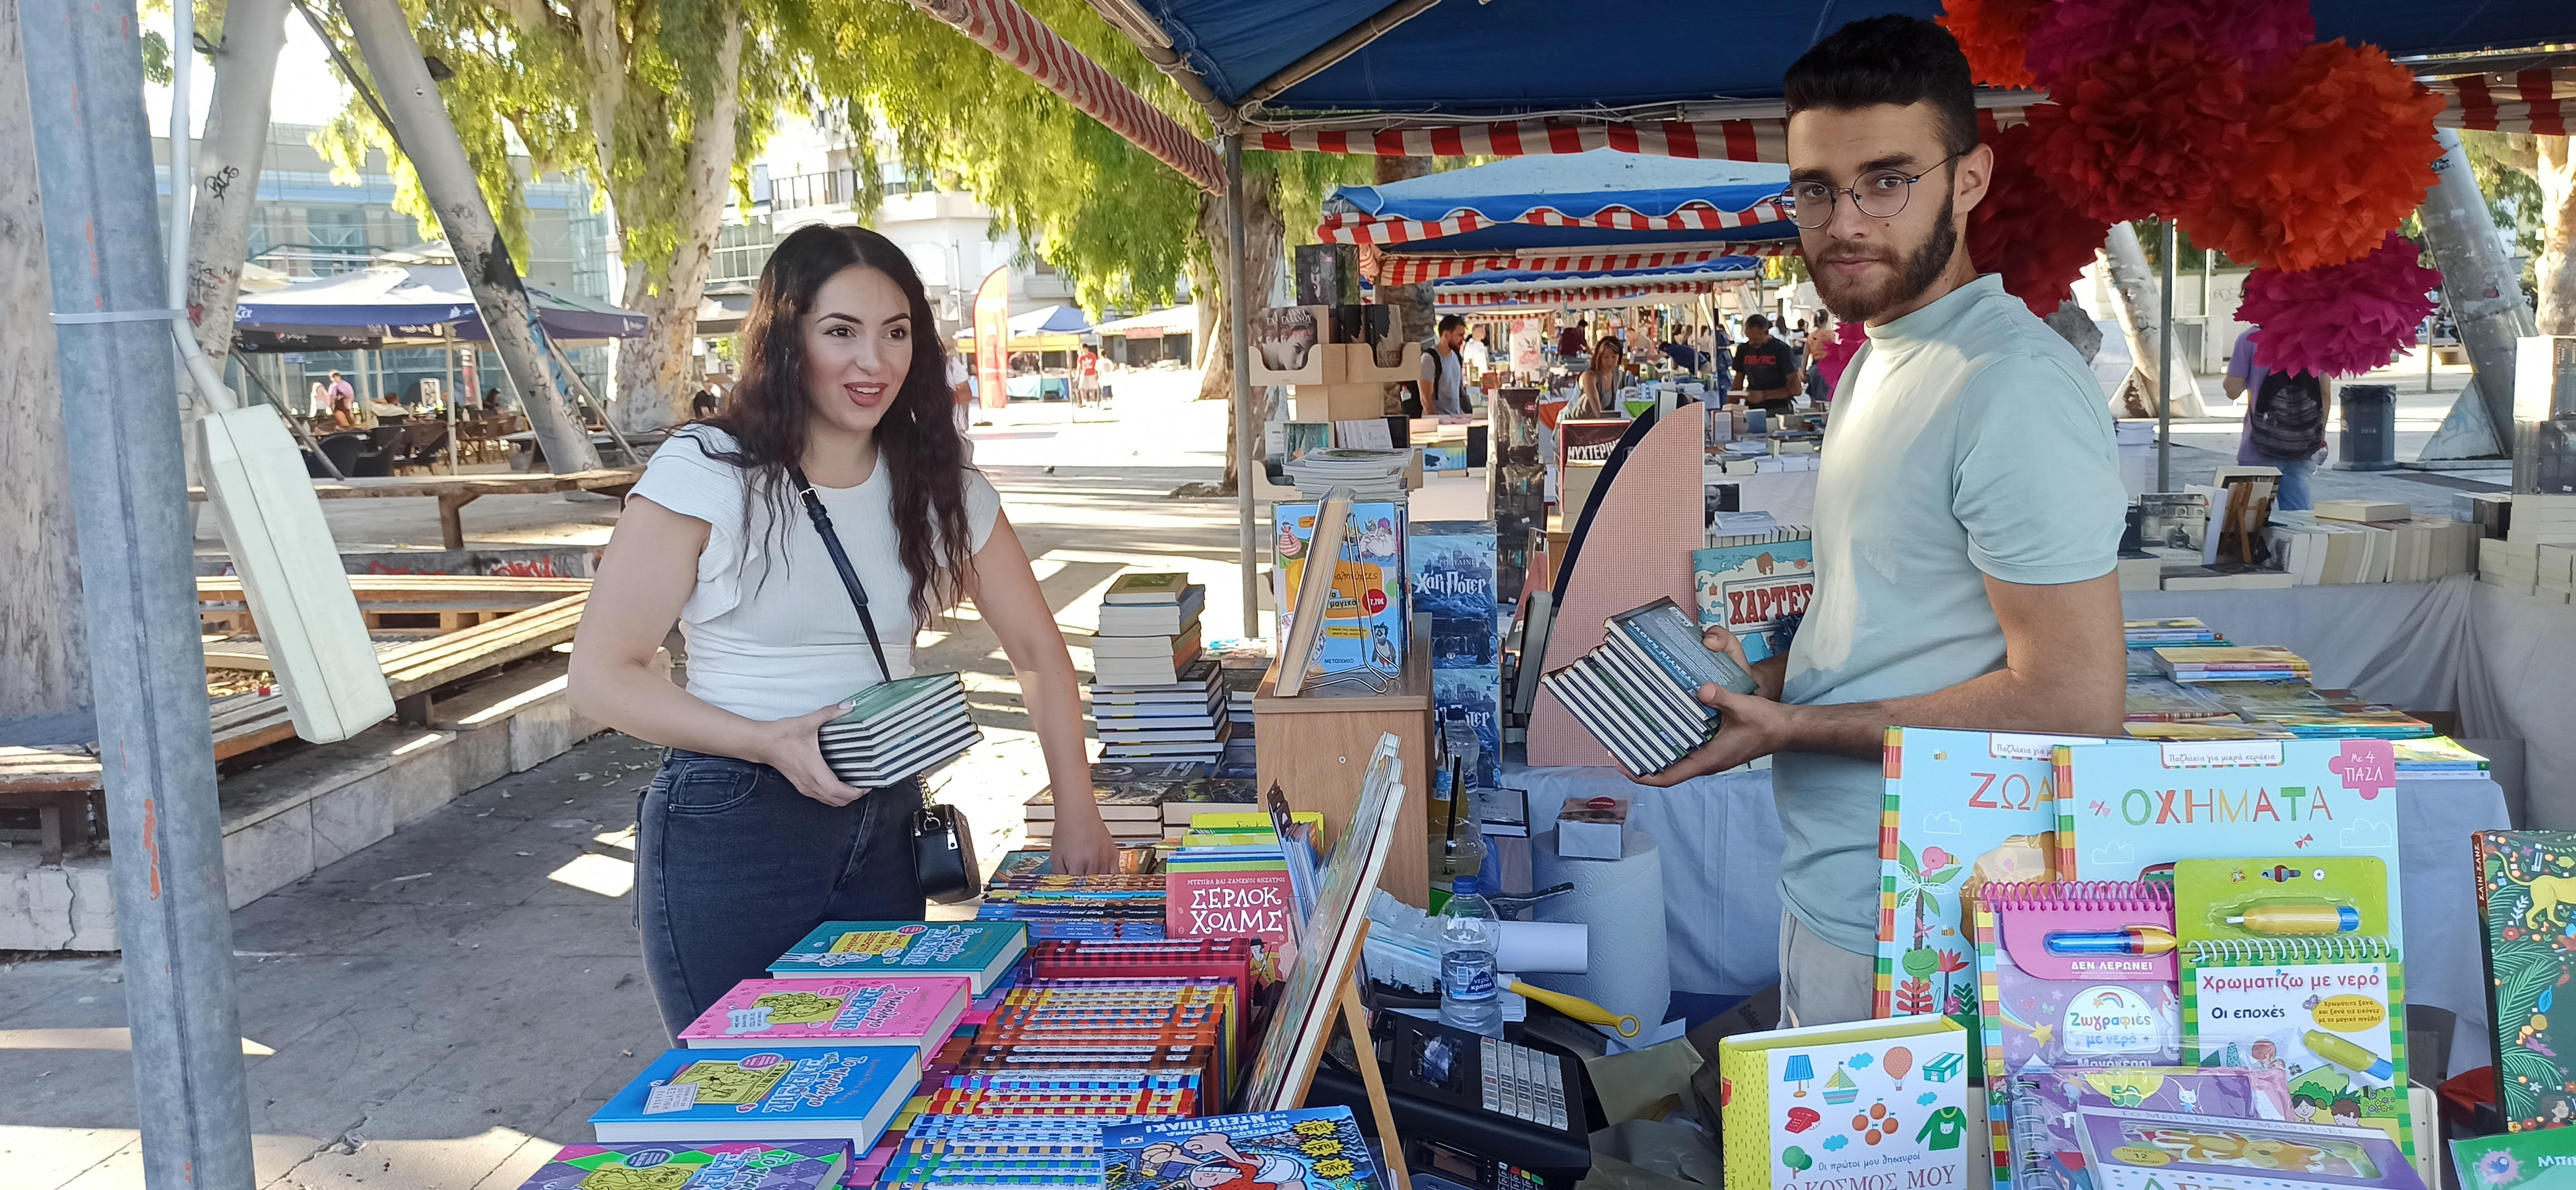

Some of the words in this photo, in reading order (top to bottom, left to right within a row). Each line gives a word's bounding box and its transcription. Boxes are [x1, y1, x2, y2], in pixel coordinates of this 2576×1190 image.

[1728, 583, 1813, 625] ΧΑΡΤΕΣ
[2168, 752, 2205, 763] Παζλάκια
[2206, 754, 2219, 764] για
[2221, 752, 2243, 763] μικρά
[2245, 752, 2276, 763] χεράκια
[2351, 753, 2363, 763] Με
[2365, 750, 2375, 763] 4
[2344, 767, 2384, 782] ΠΑΖΛ
[1968, 772, 2053, 811] ΖΩΑ
[2121, 785, 2333, 826] ΟΧΗΜΑΤΑ
[1190, 887, 1282, 909] ΣΕΡΛΟΚ
[1189, 909, 1284, 934] ΧΟΛΜΣ
[2071, 960, 2095, 970] ΔΕΝ
[2099, 960, 2153, 970] ΛΕΡΩΝΕΙ
[1474, 974, 1489, 985] νερά
[2202, 968, 2304, 993] Χρωματίζω
[2311, 975, 2331, 991] με
[2337, 966, 2380, 989] νερό
[830, 987, 885, 1031] ΞΕΝΕΡΩΤΗΣ
[2212, 1006, 2228, 1020] Οι
[2233, 1004, 2285, 1018] εποχές
[2069, 1012, 2151, 1031] Ζωγραφιές
[2086, 1034, 2103, 1047] με
[2106, 1032, 2137, 1047] νερό
[840, 1056, 868, 1066] Το
[762, 1059, 826, 1113] ΞΕΝΕΡΩΤΗΣ
[1145, 1120, 1202, 1133] ΠΙΛΚΙ
[1252, 1120, 1289, 1128] ΕΠΙΚΟ
[1321, 1163, 1348, 1172] ΚΑΚΟ
[1818, 1162, 1828, 1171] Οι
[1830, 1159, 1861, 1173] πρώτοι
[1863, 1158, 1880, 1169] μου
[1882, 1151, 1921, 1165] θησαυροί
[1907, 1164, 1957, 1189] ΜΟΥ
